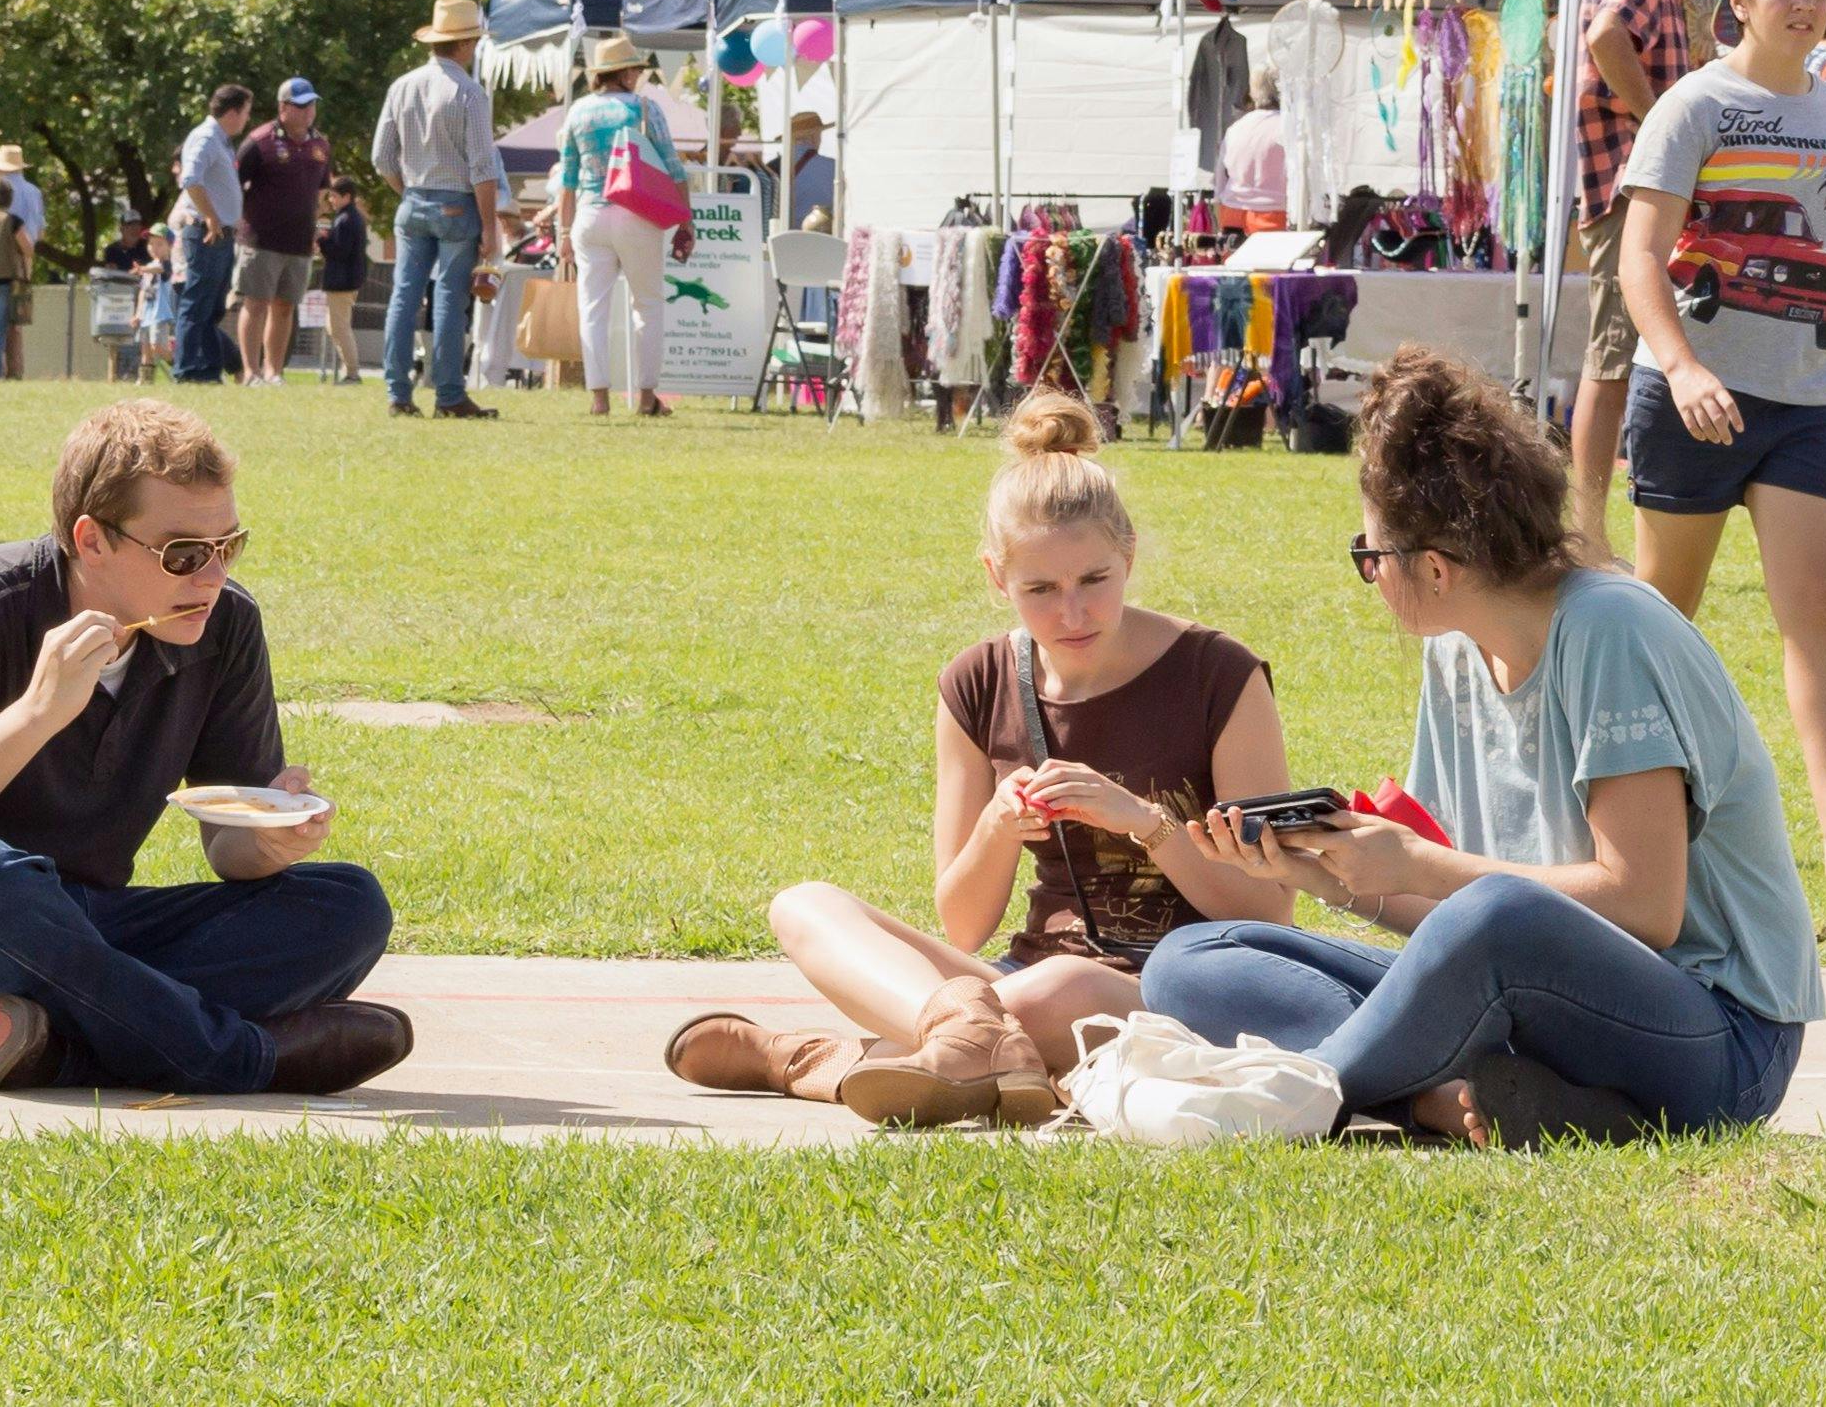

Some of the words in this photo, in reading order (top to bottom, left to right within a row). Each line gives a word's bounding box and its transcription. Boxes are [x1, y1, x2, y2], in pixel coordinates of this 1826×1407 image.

[1717, 108, 1783, 134] Ford
[693, 224, 743, 242] reek
[668, 345, 684, 355] 02
